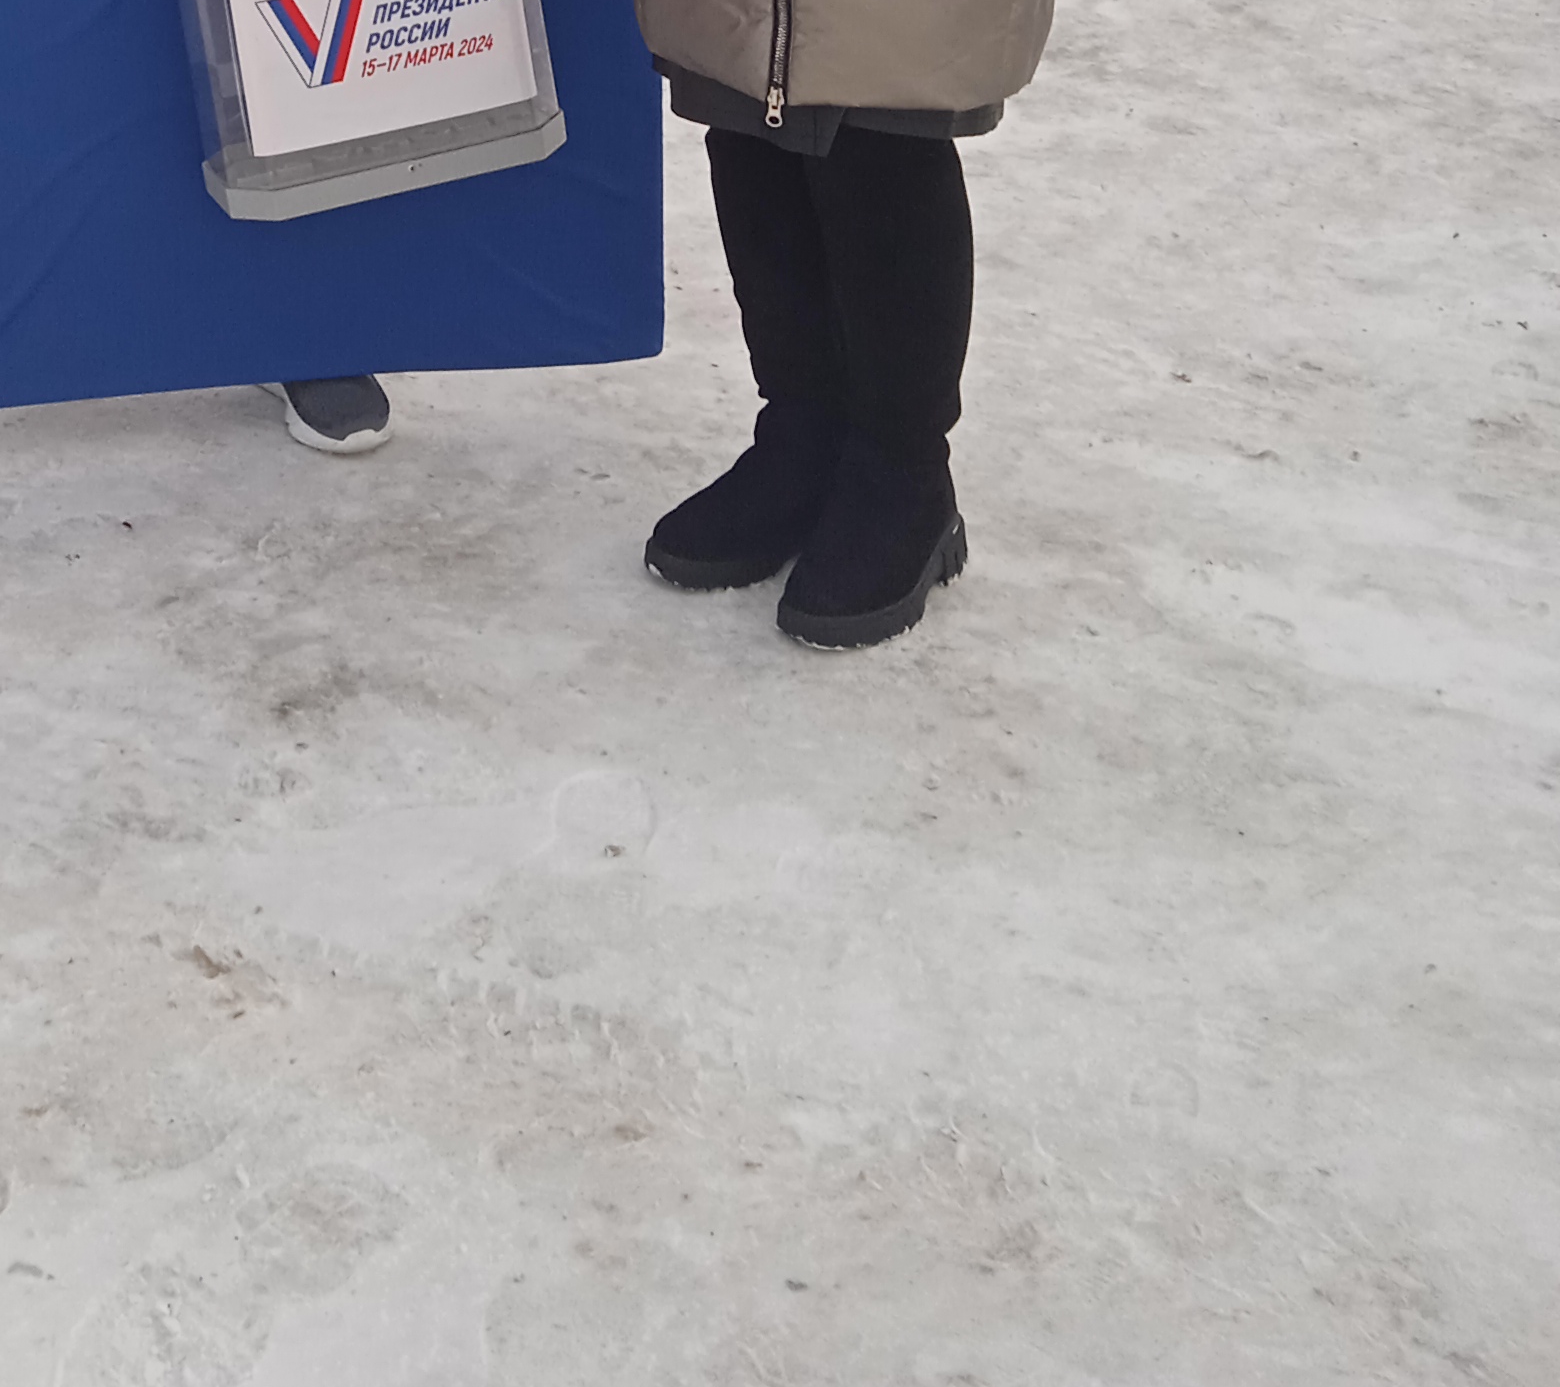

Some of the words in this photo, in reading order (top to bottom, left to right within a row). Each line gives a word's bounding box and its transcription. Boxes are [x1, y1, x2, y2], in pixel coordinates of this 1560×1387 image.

[365, 16, 452, 54] РОССИИ
[403, 41, 455, 69] МАРТА
[457, 32, 494, 58] 2024
